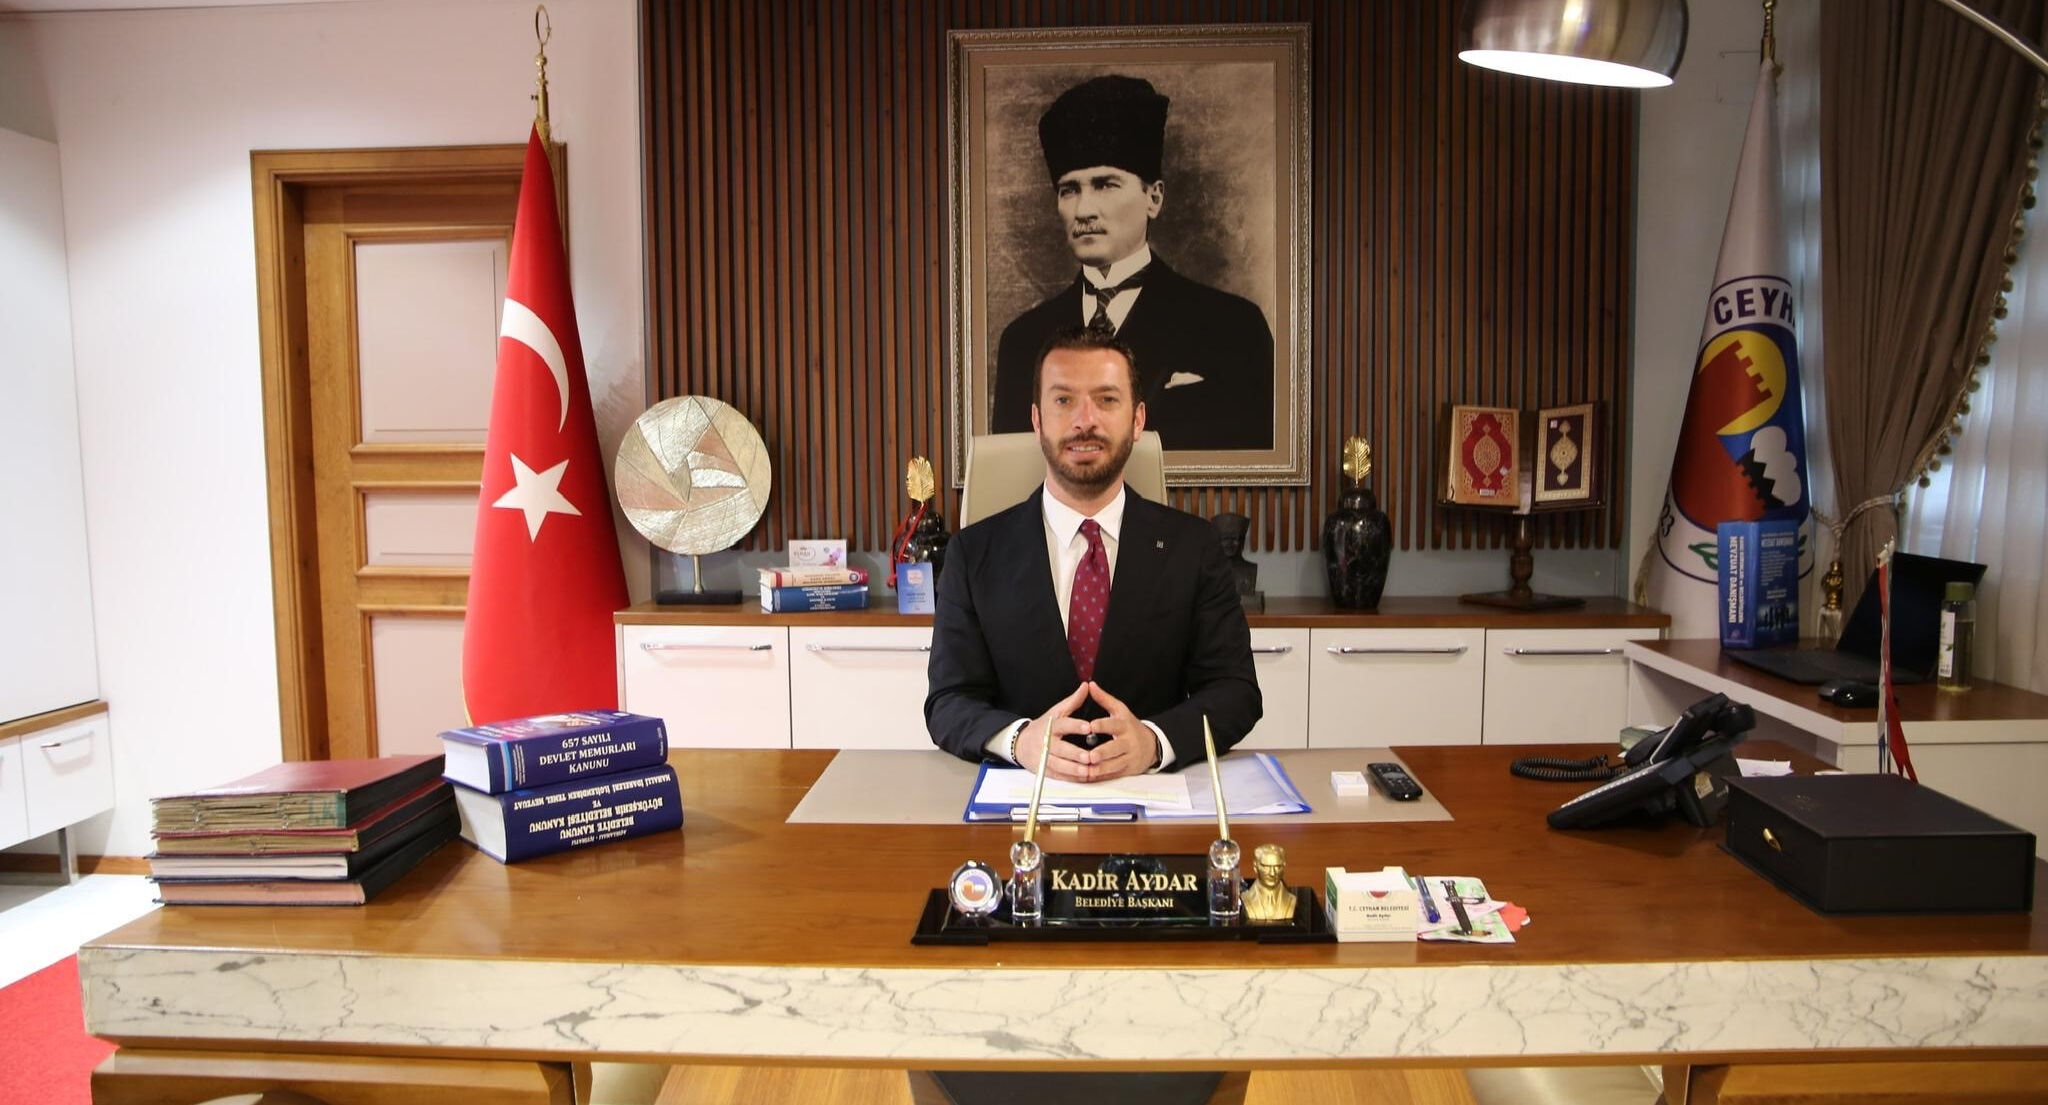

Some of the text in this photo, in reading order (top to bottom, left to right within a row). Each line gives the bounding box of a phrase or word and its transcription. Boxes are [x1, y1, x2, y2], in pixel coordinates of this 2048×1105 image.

[1714, 287, 1795, 326] CEYH
[1728, 536, 1738, 623] MEVZUAT DANIŞMANI
[562, 733, 611, 749] 657 SAYILI
[539, 741, 636, 765] DEVLET MEMURLARI
[569, 758, 609, 774] KANUNU
[545, 793, 567, 805] TEMEL
[567, 784, 610, 799] İLGİLENDİREN
[513, 797, 544, 810] MEVZUAT
[592, 799, 602, 807] VE
[529, 797, 663, 833] BÜYÜKŞEHİR BELEDİYESİ KANUNU
[559, 816, 635, 840] BELEDİYE KANUNU
[1051, 869, 1198, 892] KADİR AYDAR
[1075, 896, 1173, 909] BELEDİYE BAŞKANI
